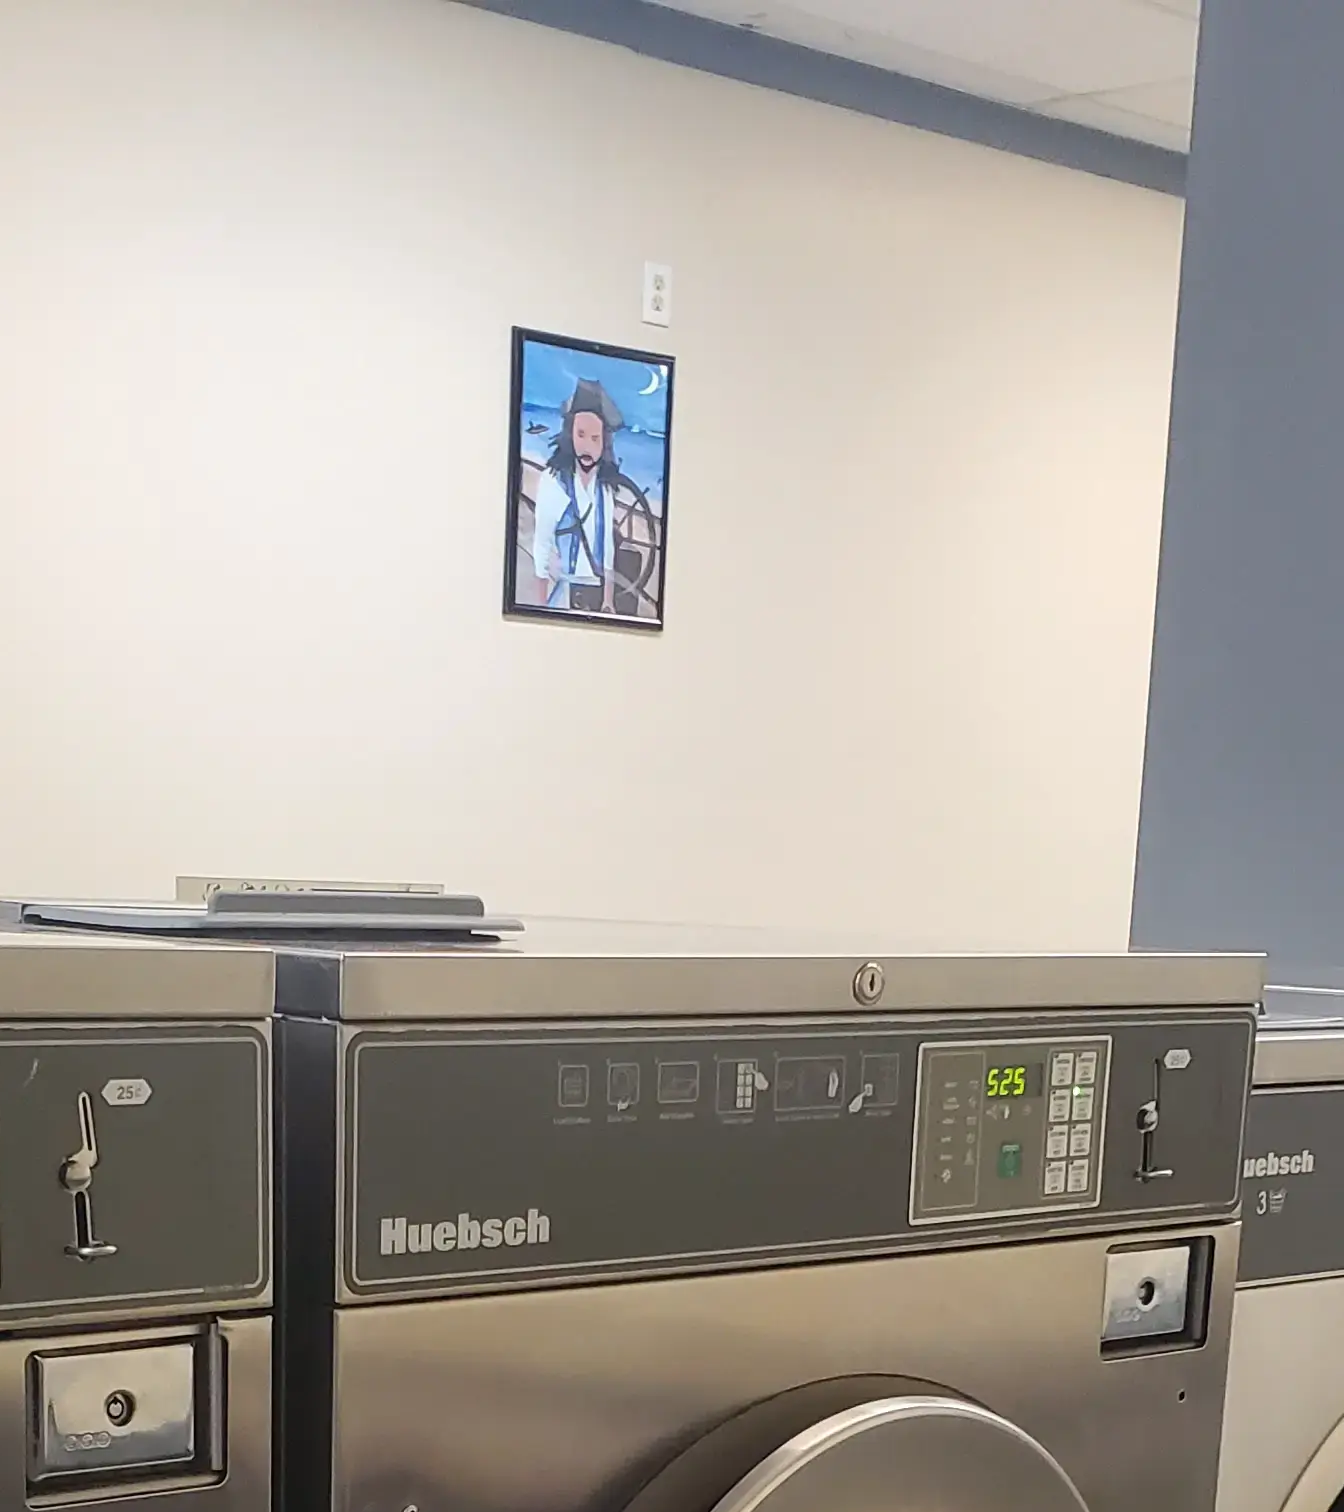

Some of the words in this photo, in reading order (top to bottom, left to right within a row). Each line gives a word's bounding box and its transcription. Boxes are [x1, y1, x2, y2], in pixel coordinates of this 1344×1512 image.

[987, 1067, 1025, 1096] 525
[1243, 1150, 1315, 1178] uebsch
[1256, 1191, 1267, 1215] 3
[380, 1208, 550, 1255] Huebsch
